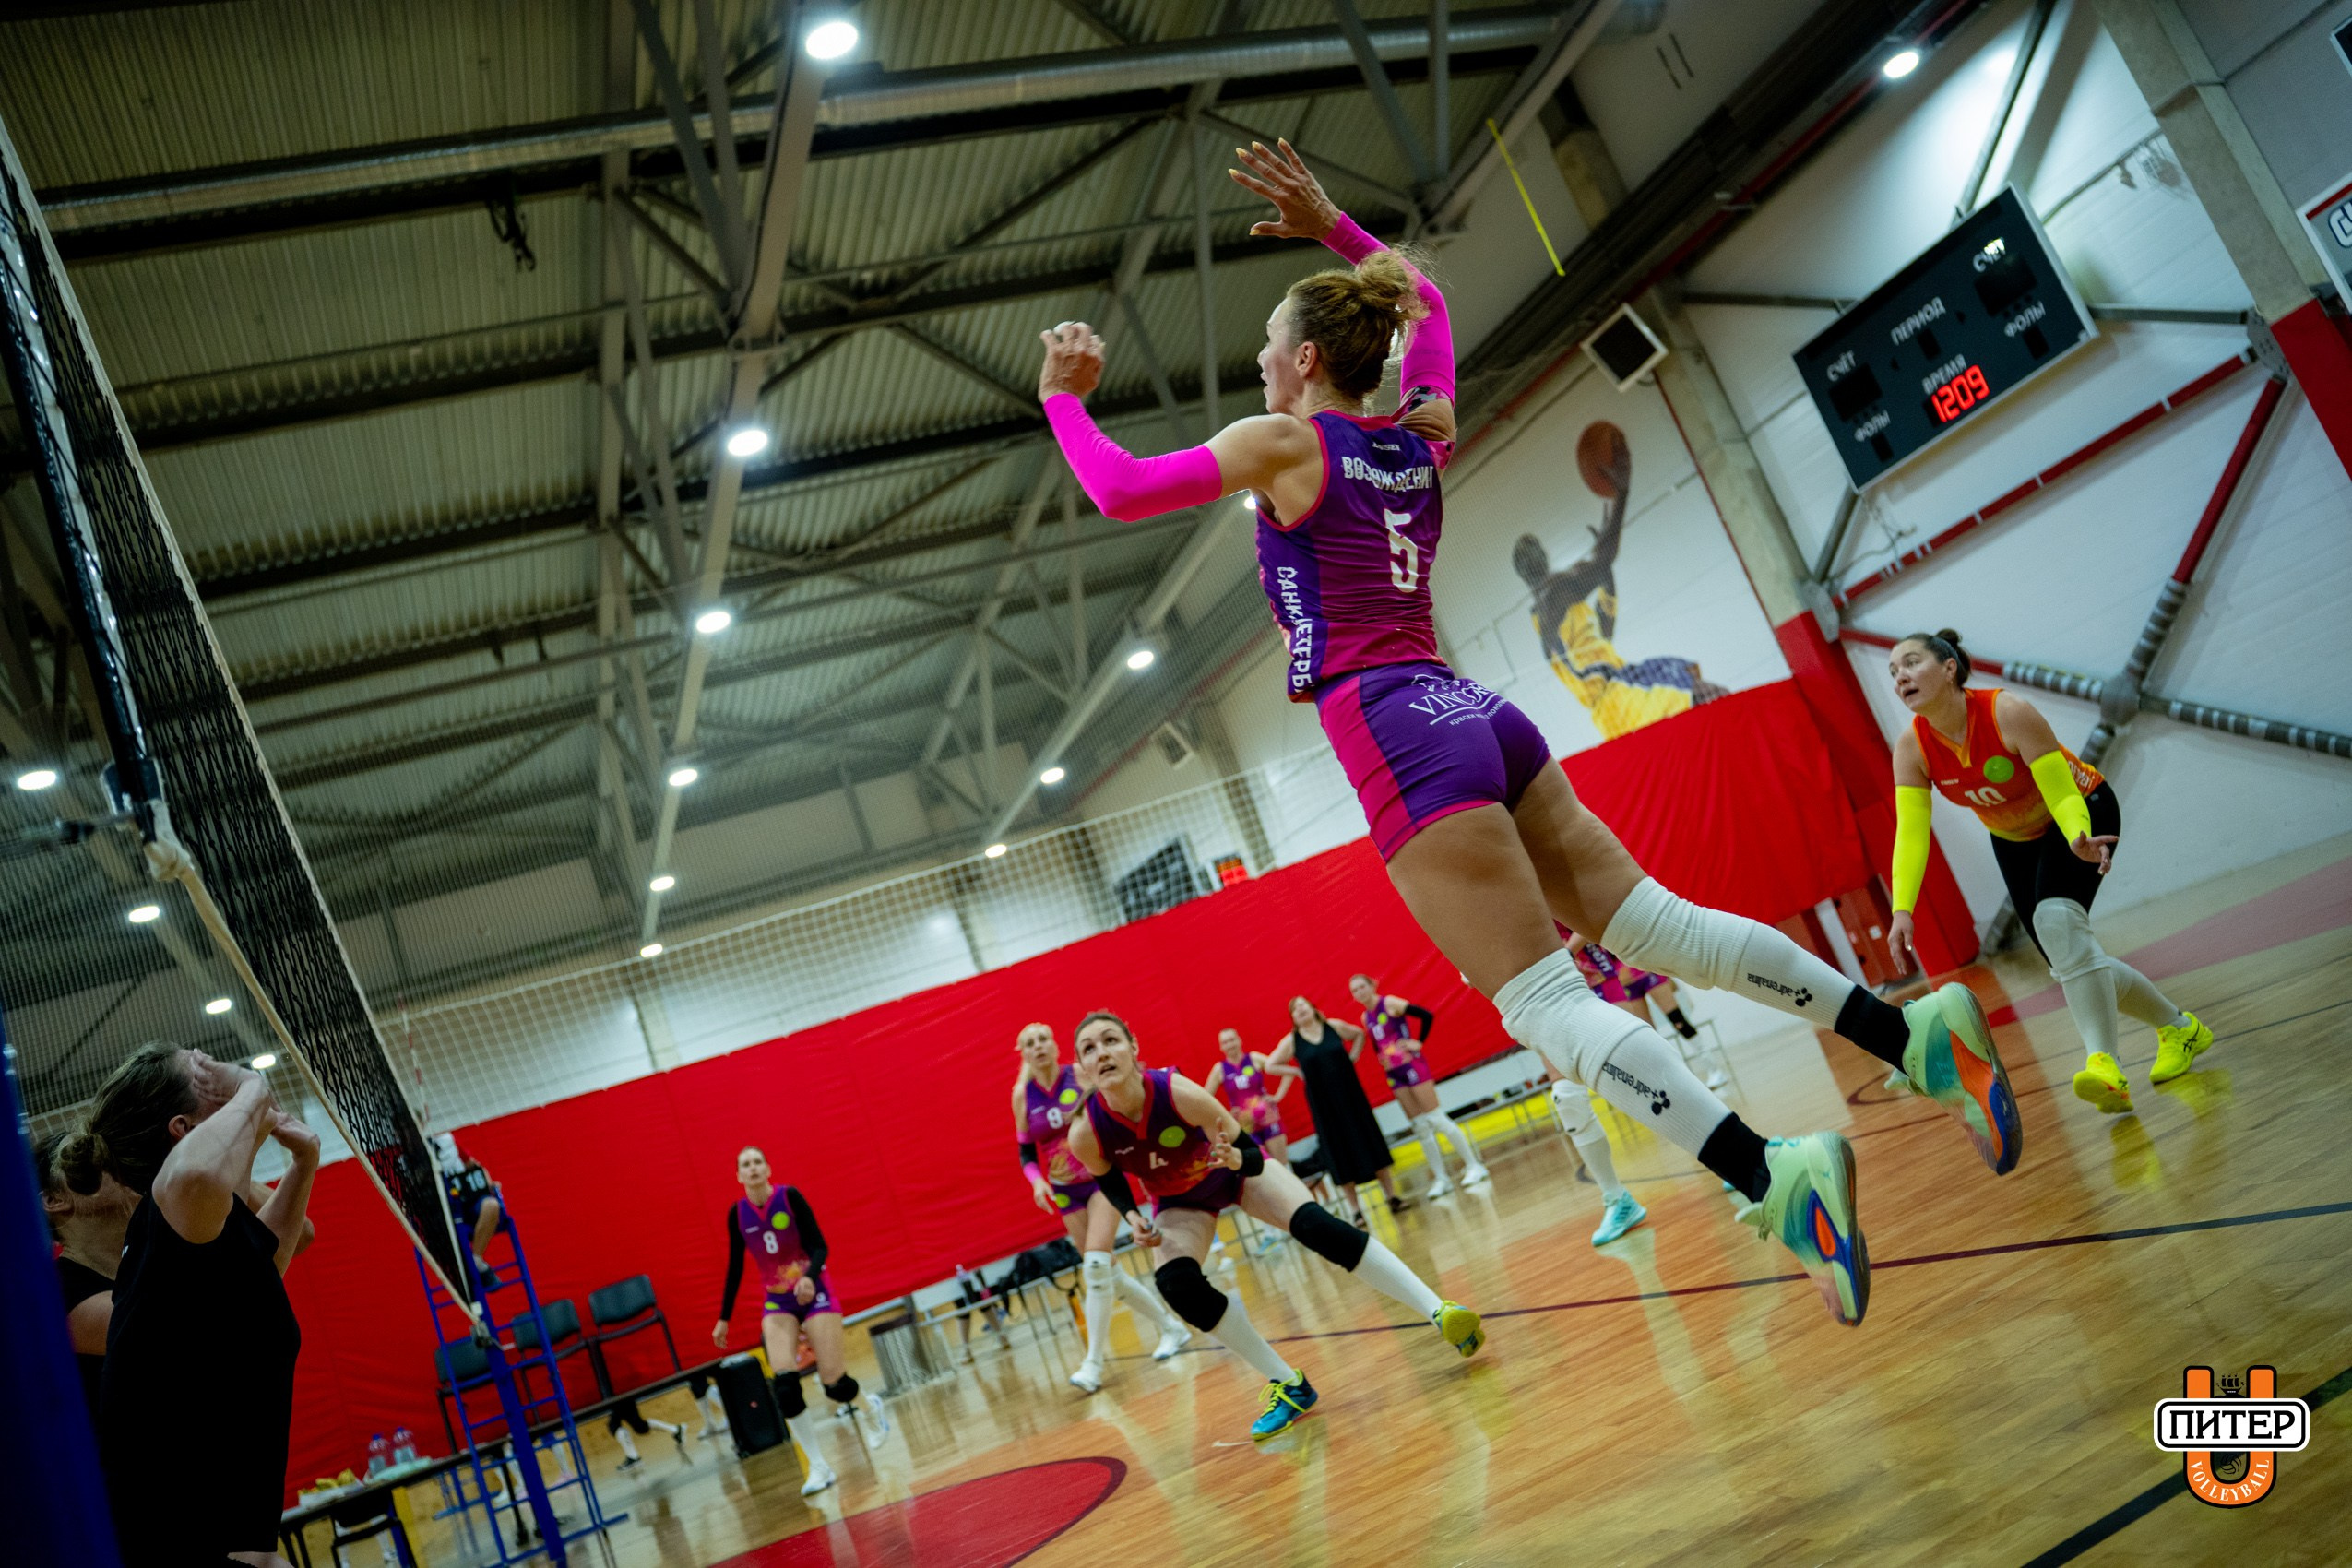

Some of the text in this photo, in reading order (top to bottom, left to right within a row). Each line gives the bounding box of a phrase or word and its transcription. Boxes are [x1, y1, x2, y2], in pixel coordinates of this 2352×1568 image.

[1891, 296, 1946, 346] ПЕРИОД
[2004, 301, 2046, 338] ФОЛЫ
[1922, 353, 1966, 396] ВРЕМЯ
[1930, 364, 1990, 423] 1209
[1854, 410, 1891, 442] ФОЛЫ
[1384, 508, 1419, 593] 5
[1964, 786, 2007, 808] 10
[1046, 1106, 1063, 1130] 9
[763, 1230, 779, 1254] 8
